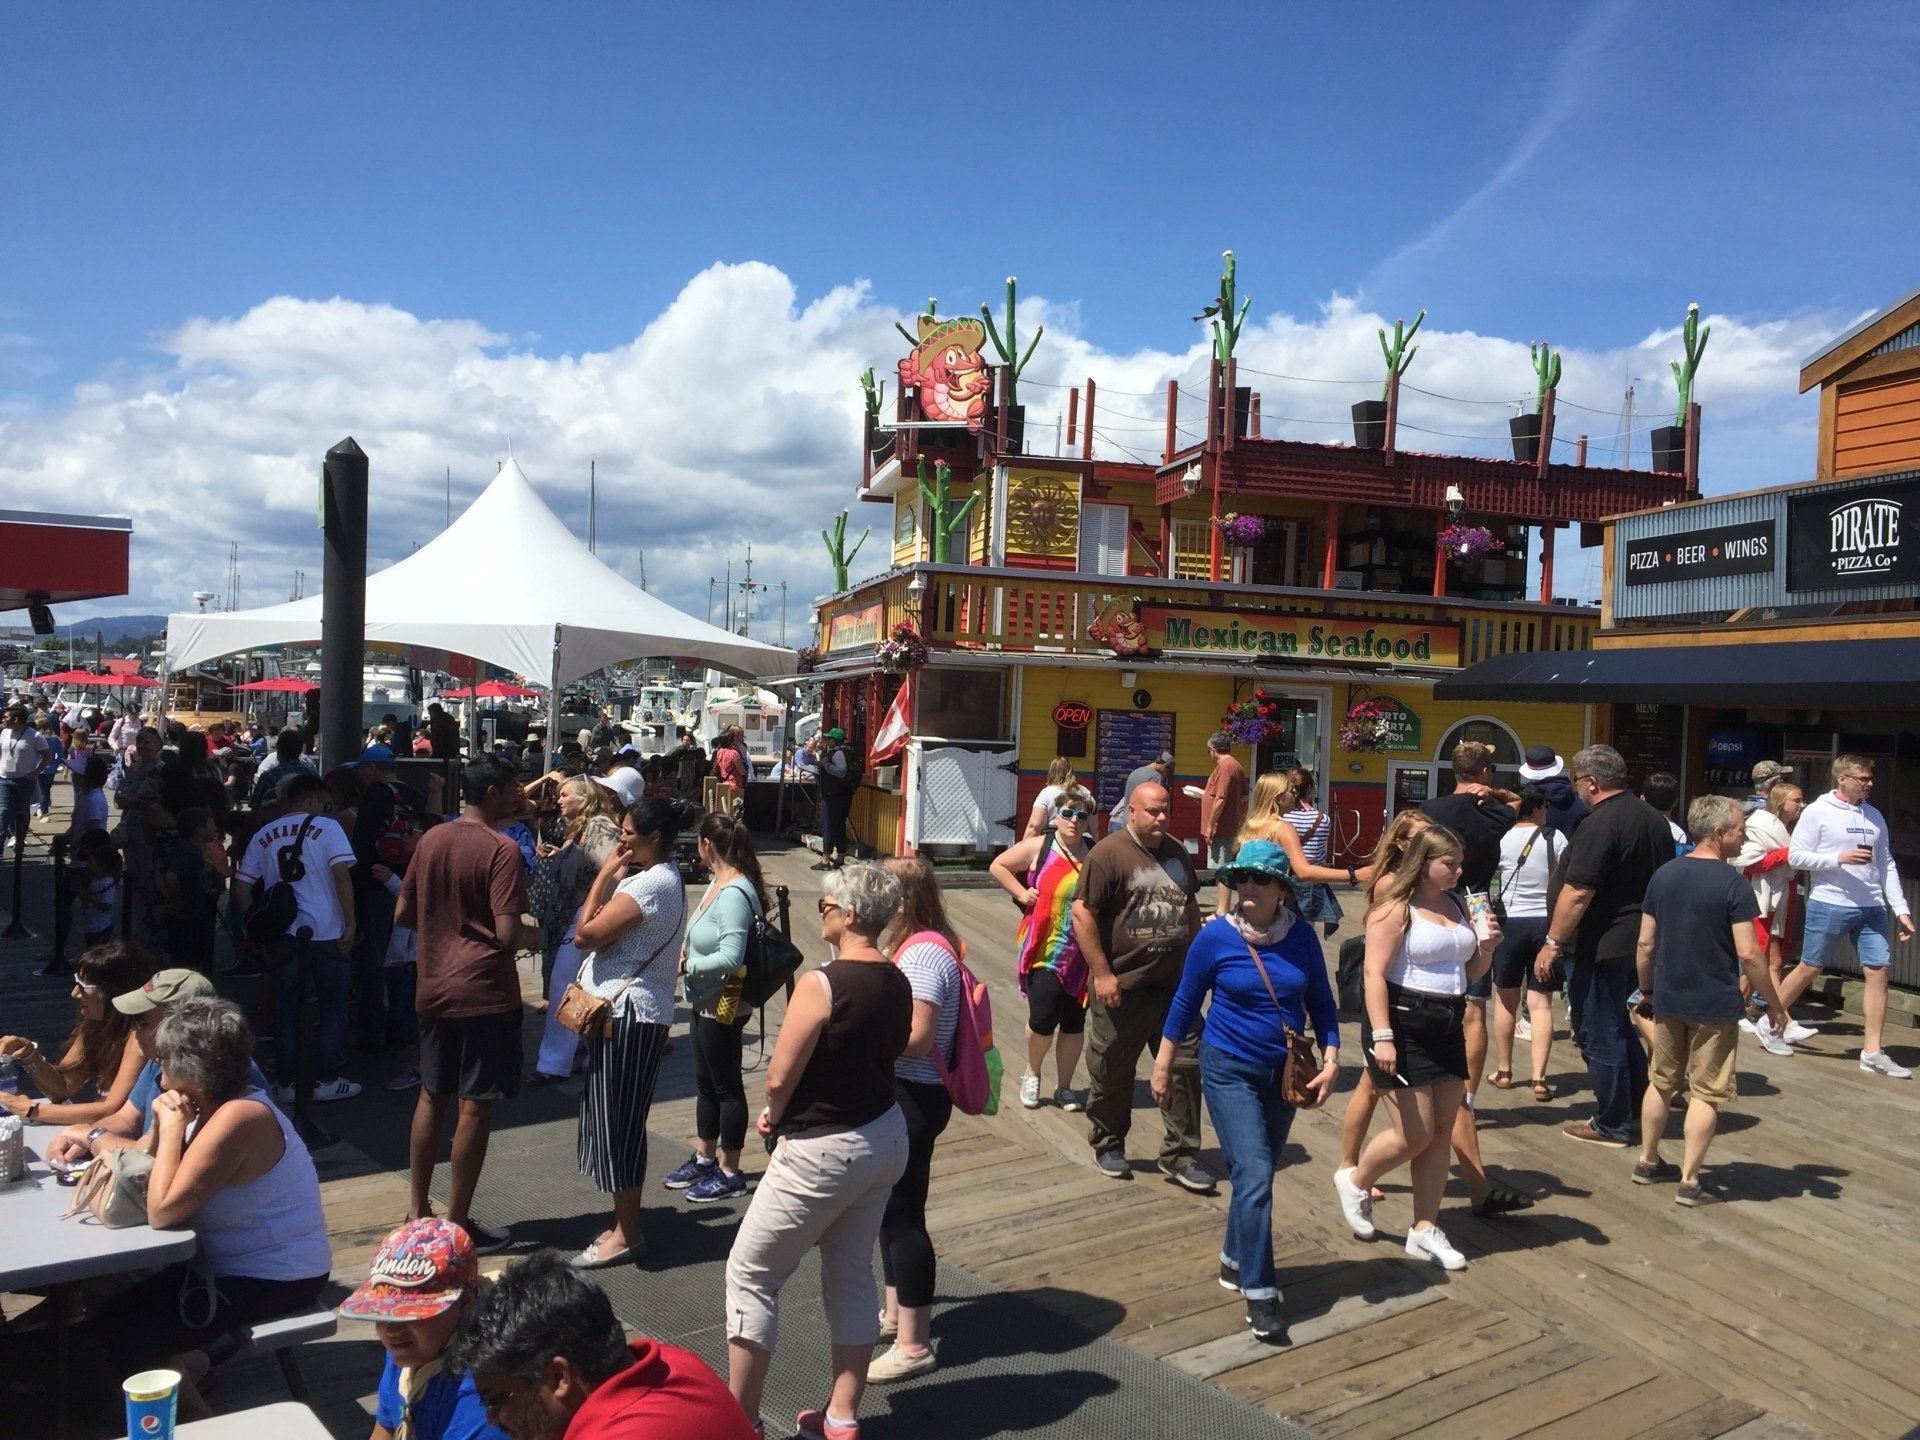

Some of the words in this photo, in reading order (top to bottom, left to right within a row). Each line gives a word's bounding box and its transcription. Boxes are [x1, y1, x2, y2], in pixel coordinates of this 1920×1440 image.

[1830, 502, 1900, 554] PIRATE
[1630, 551, 1660, 571] PIZZA
[1677, 545, 1706, 566] BEER
[1724, 536, 1768, 560] WINGS
[1837, 555, 1873, 570] PIZZA
[1874, 553, 1891, 567] Co
[1163, 617, 1298, 655] Mexican
[1307, 625, 1431, 662] Seafood
[1056, 708, 1091, 722] OPEN
[1635, 703, 1659, 714] MENU
[1717, 741, 1743, 753] pepsi
[259, 824, 323, 849] SAKAMTO
[370, 1247, 437, 1277] London
